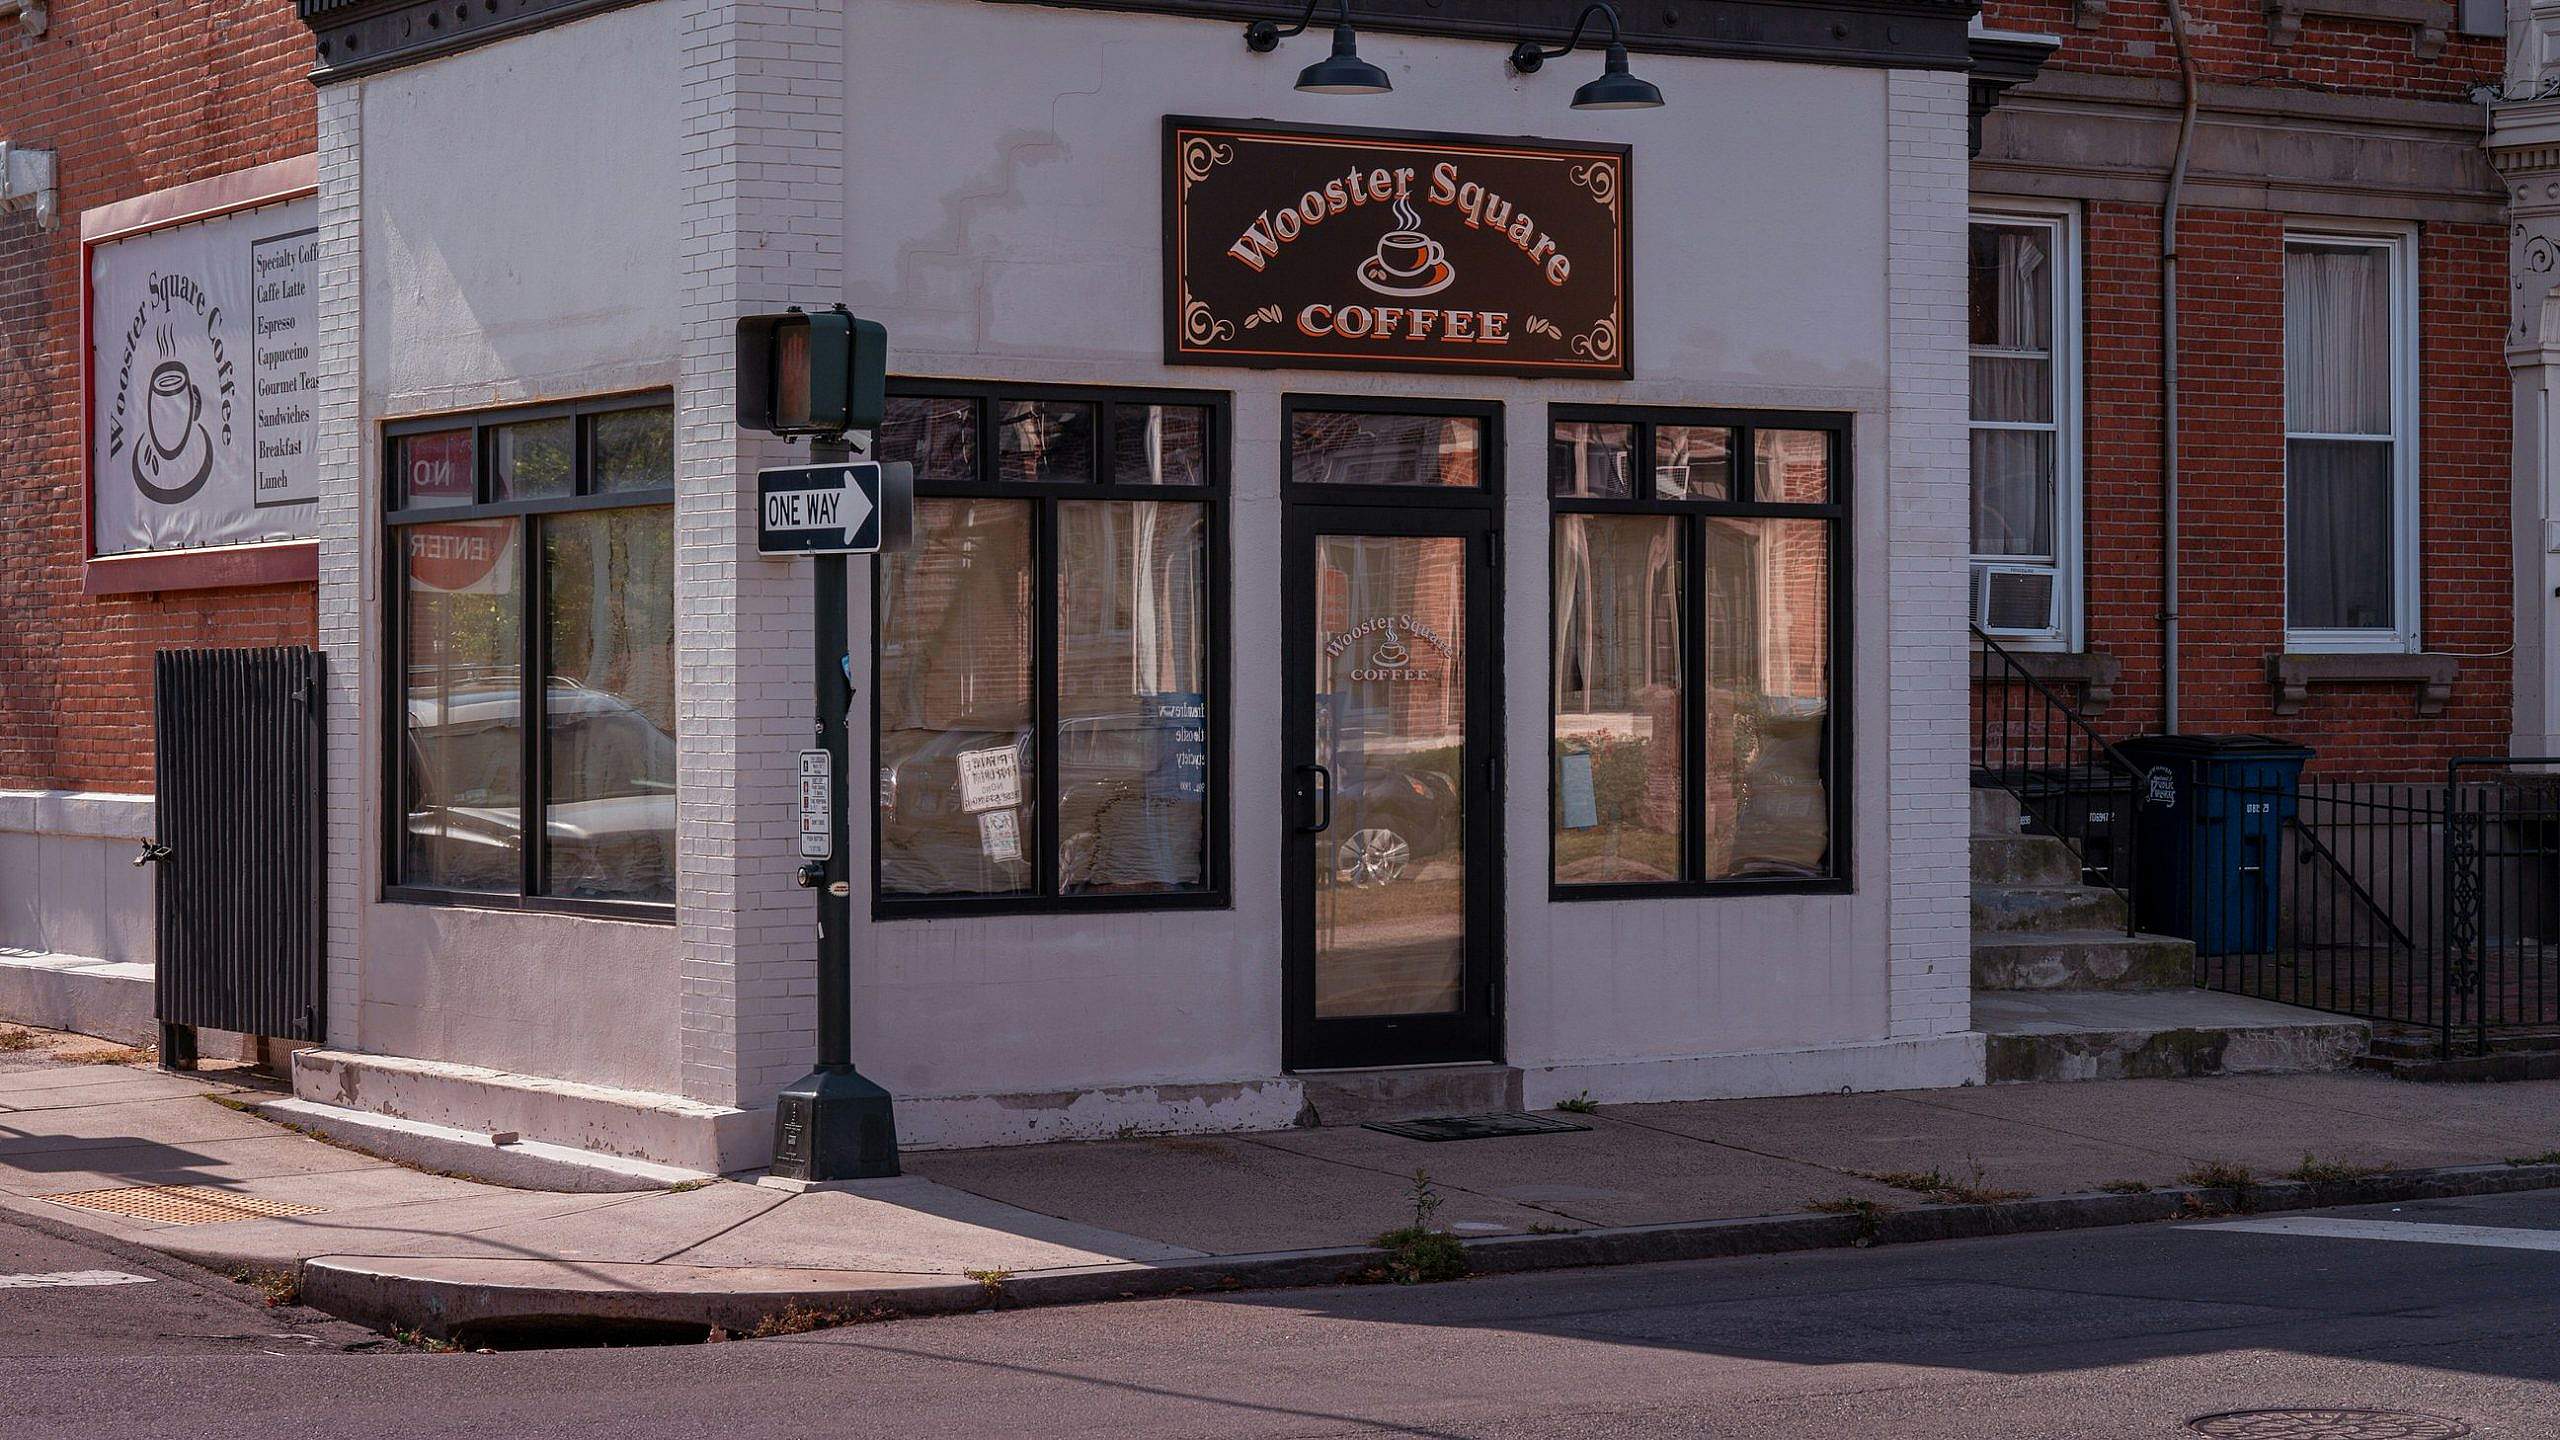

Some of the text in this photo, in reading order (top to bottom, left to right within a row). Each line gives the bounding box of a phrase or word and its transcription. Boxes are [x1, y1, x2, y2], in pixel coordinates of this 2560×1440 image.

[1228, 162, 1571, 286] Wooster Square
[256, 249, 297, 278] Specialty
[282, 281, 305, 299] Latte
[256, 316, 295, 339] Espresso
[1297, 304, 1509, 344] COFFEE
[110, 270, 235, 460] Wooster Square Coffee
[258, 342, 308, 370] Cappuccino
[258, 378, 297, 396] Gourmet
[258, 405, 310, 428] Sandwiches
[258, 438, 302, 459] Breakfast
[258, 469, 288, 490] Lunch
[768, 492, 840, 526] ONE WAY
[1326, 614, 1453, 659] Wooster Square
[1350, 669, 1429, 681] COFFEE
